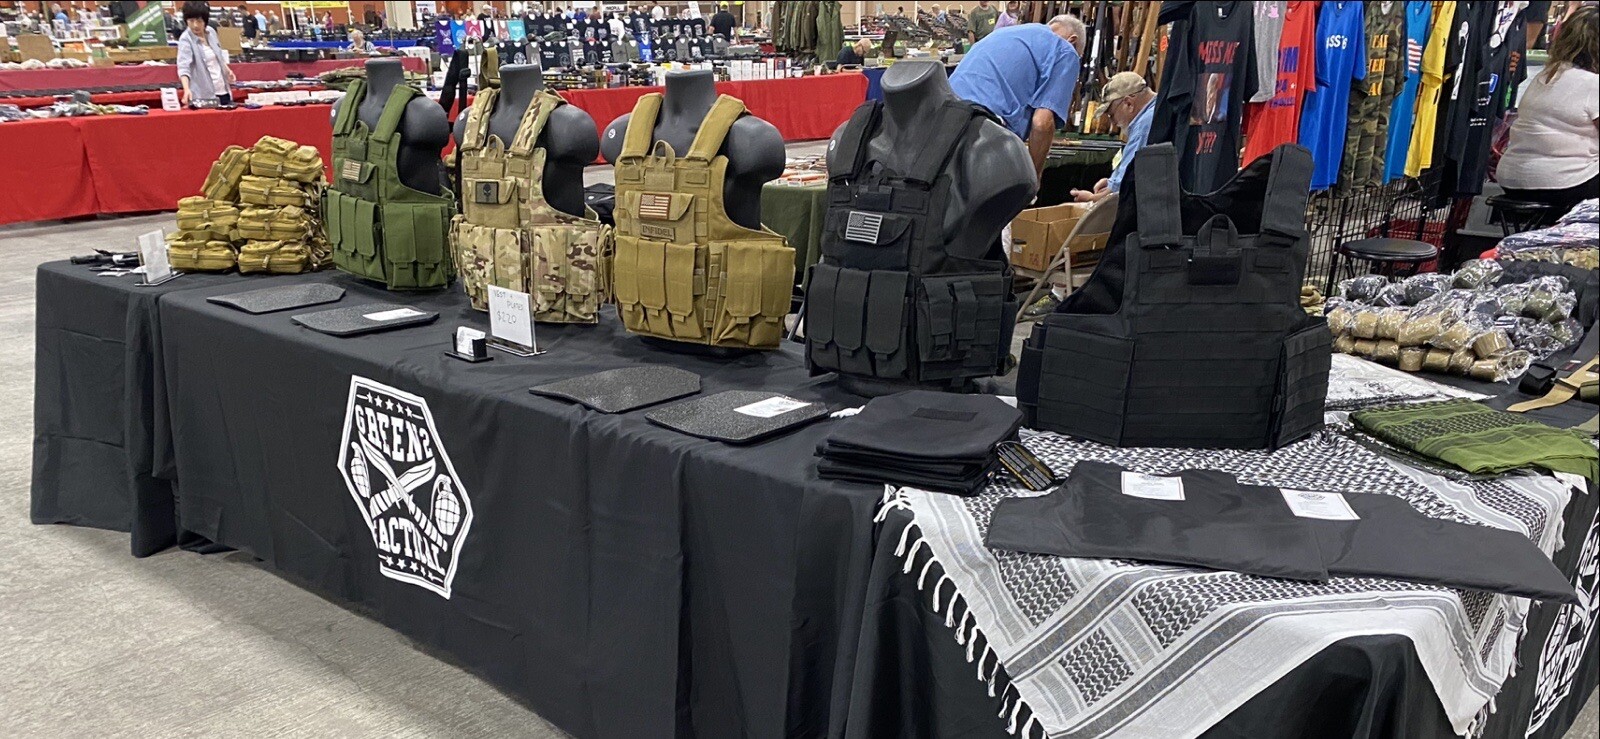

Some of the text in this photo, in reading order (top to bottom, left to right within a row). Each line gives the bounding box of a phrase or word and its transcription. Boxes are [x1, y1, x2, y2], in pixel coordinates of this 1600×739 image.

[642, 225, 673, 237] INFIDEL
[493, 290, 506, 299] VEST
[496, 310, 518, 324] $220
